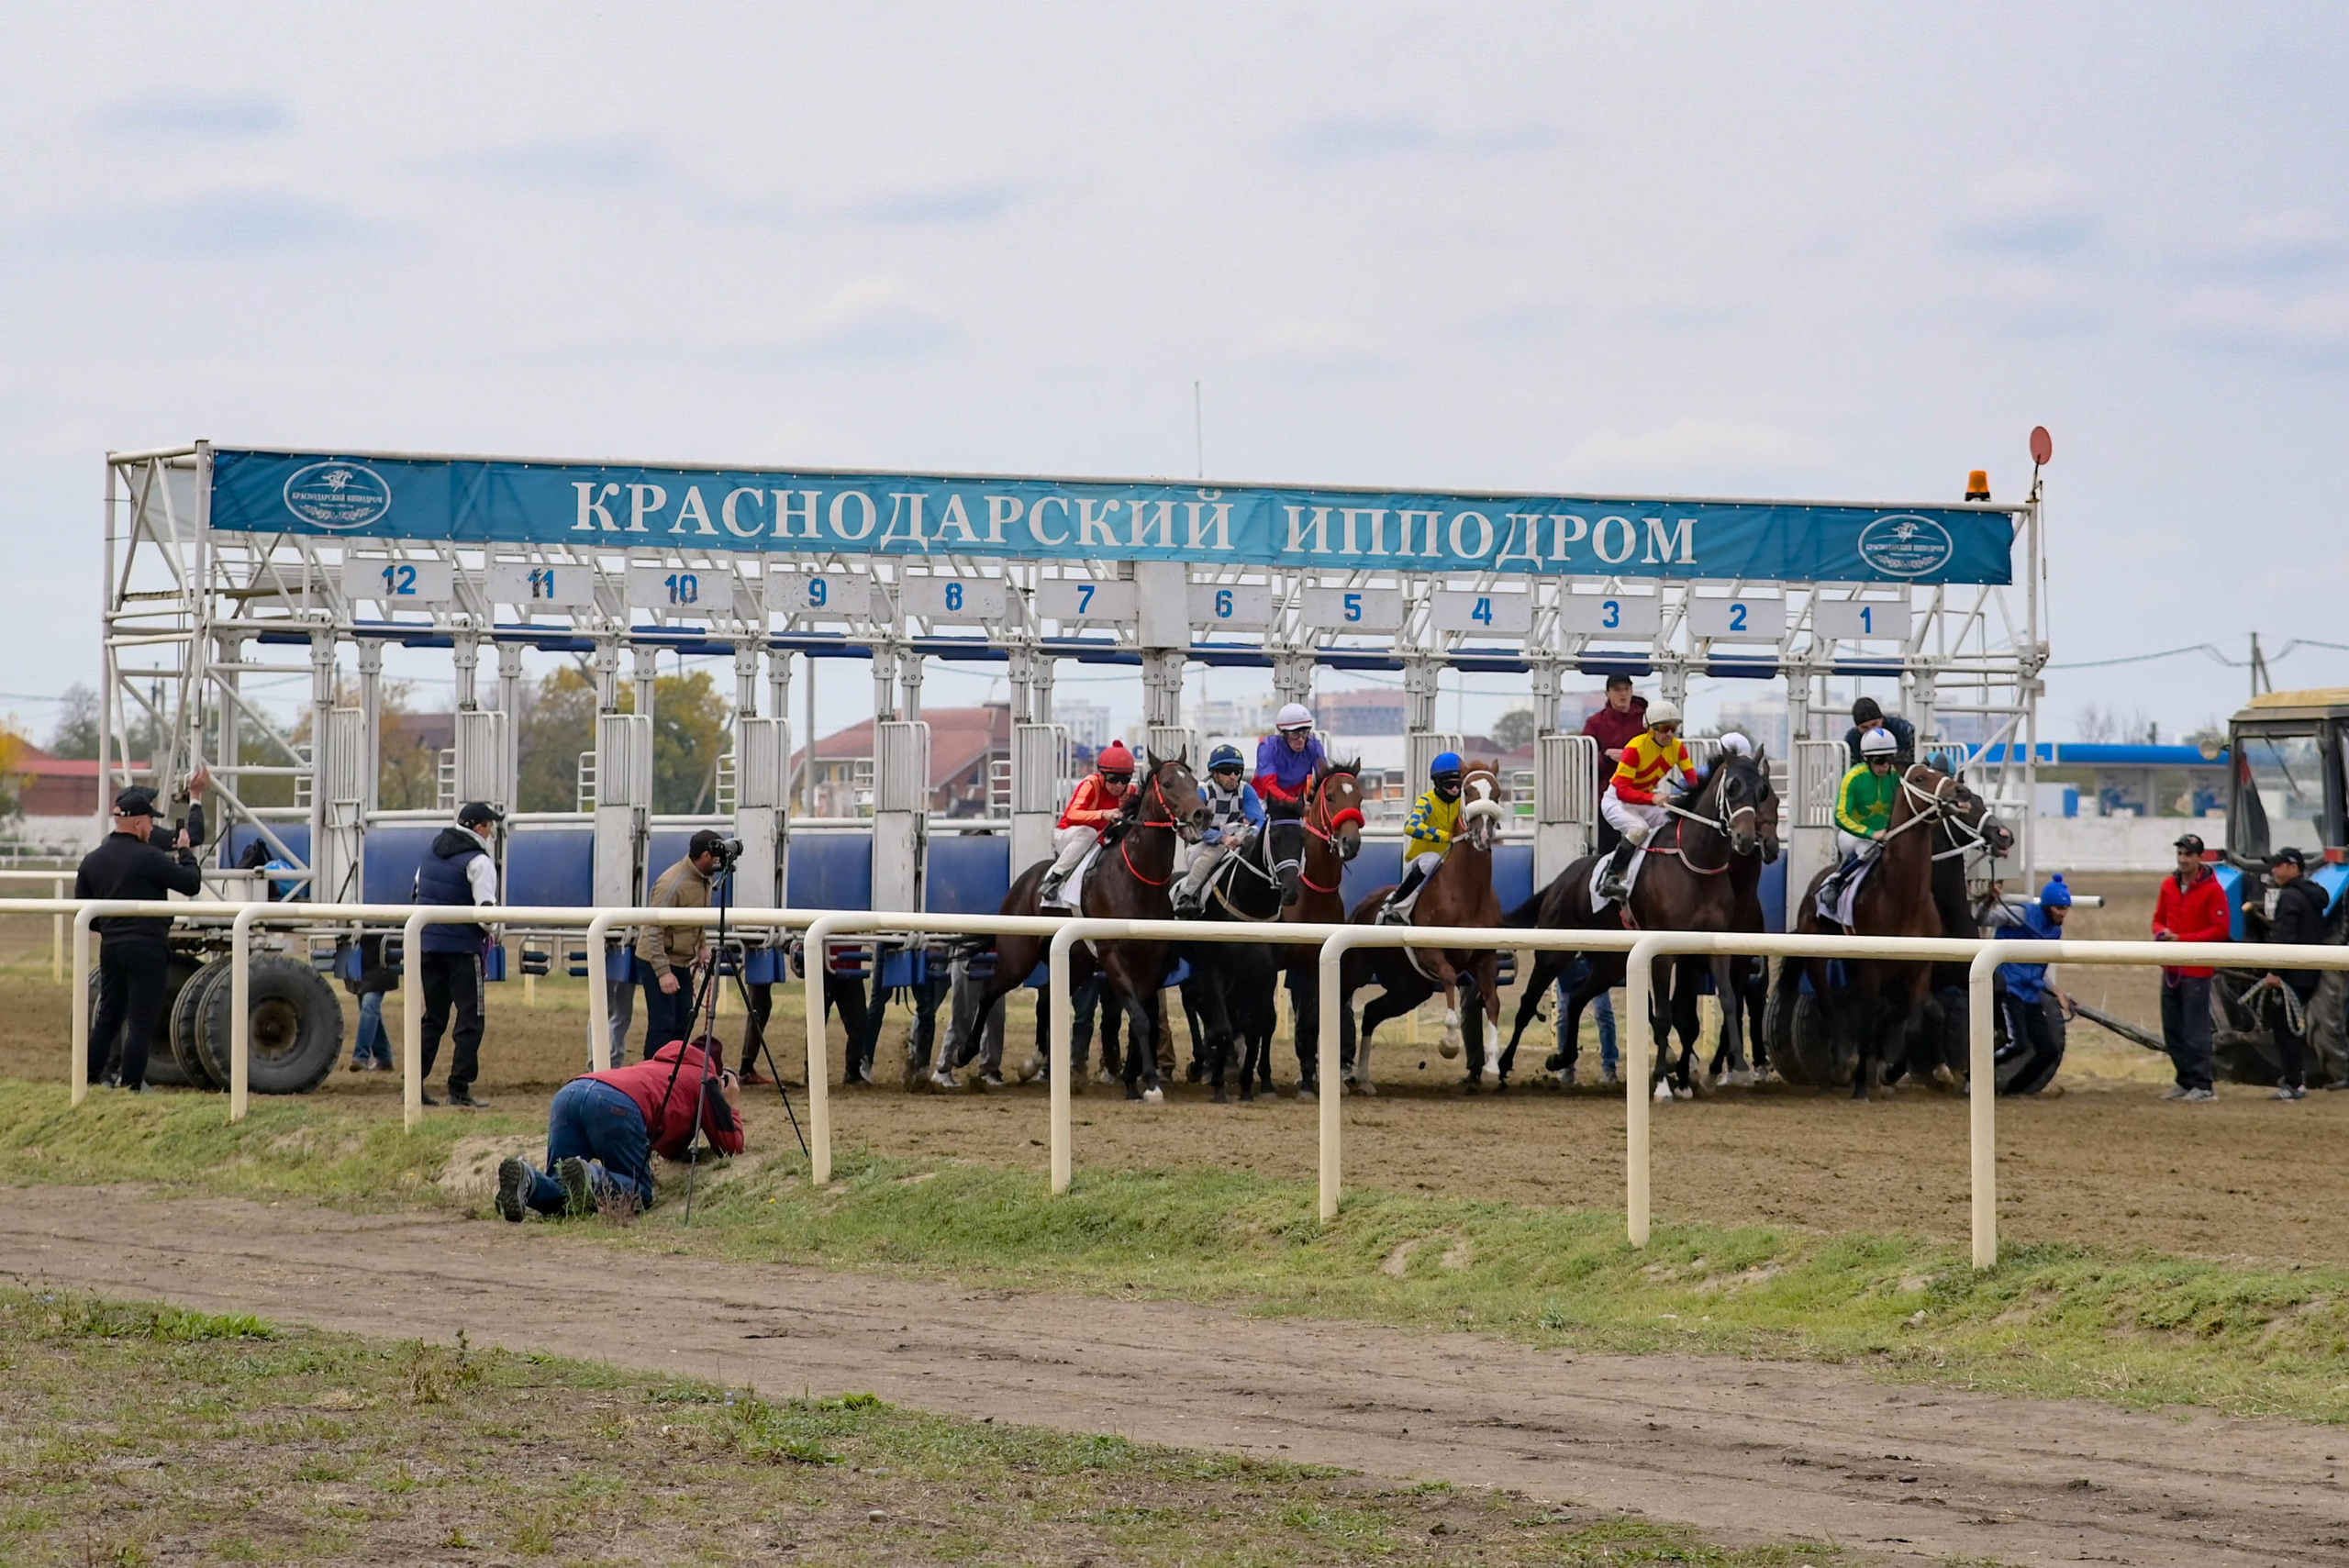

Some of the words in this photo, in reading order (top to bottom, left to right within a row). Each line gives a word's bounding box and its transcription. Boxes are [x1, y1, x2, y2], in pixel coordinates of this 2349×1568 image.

[571, 482, 1235, 552] КРАСНОДАРСКИЙ
[1282, 506, 1698, 571] ИППОДРОМ
[382, 565, 417, 595] 12
[528, 568, 554, 599] 11
[664, 574, 697, 606] 10
[808, 578, 828, 606] 9
[945, 583, 963, 611] 8
[1077, 584, 1096, 614] 7
[1216, 589, 1233, 618] 6
[1344, 594, 1362, 622] 5
[1472, 597, 1493, 626] 4
[1602, 600, 1620, 628] 3
[1730, 603, 1747, 631] 2
[1860, 606, 1872, 634] 1
